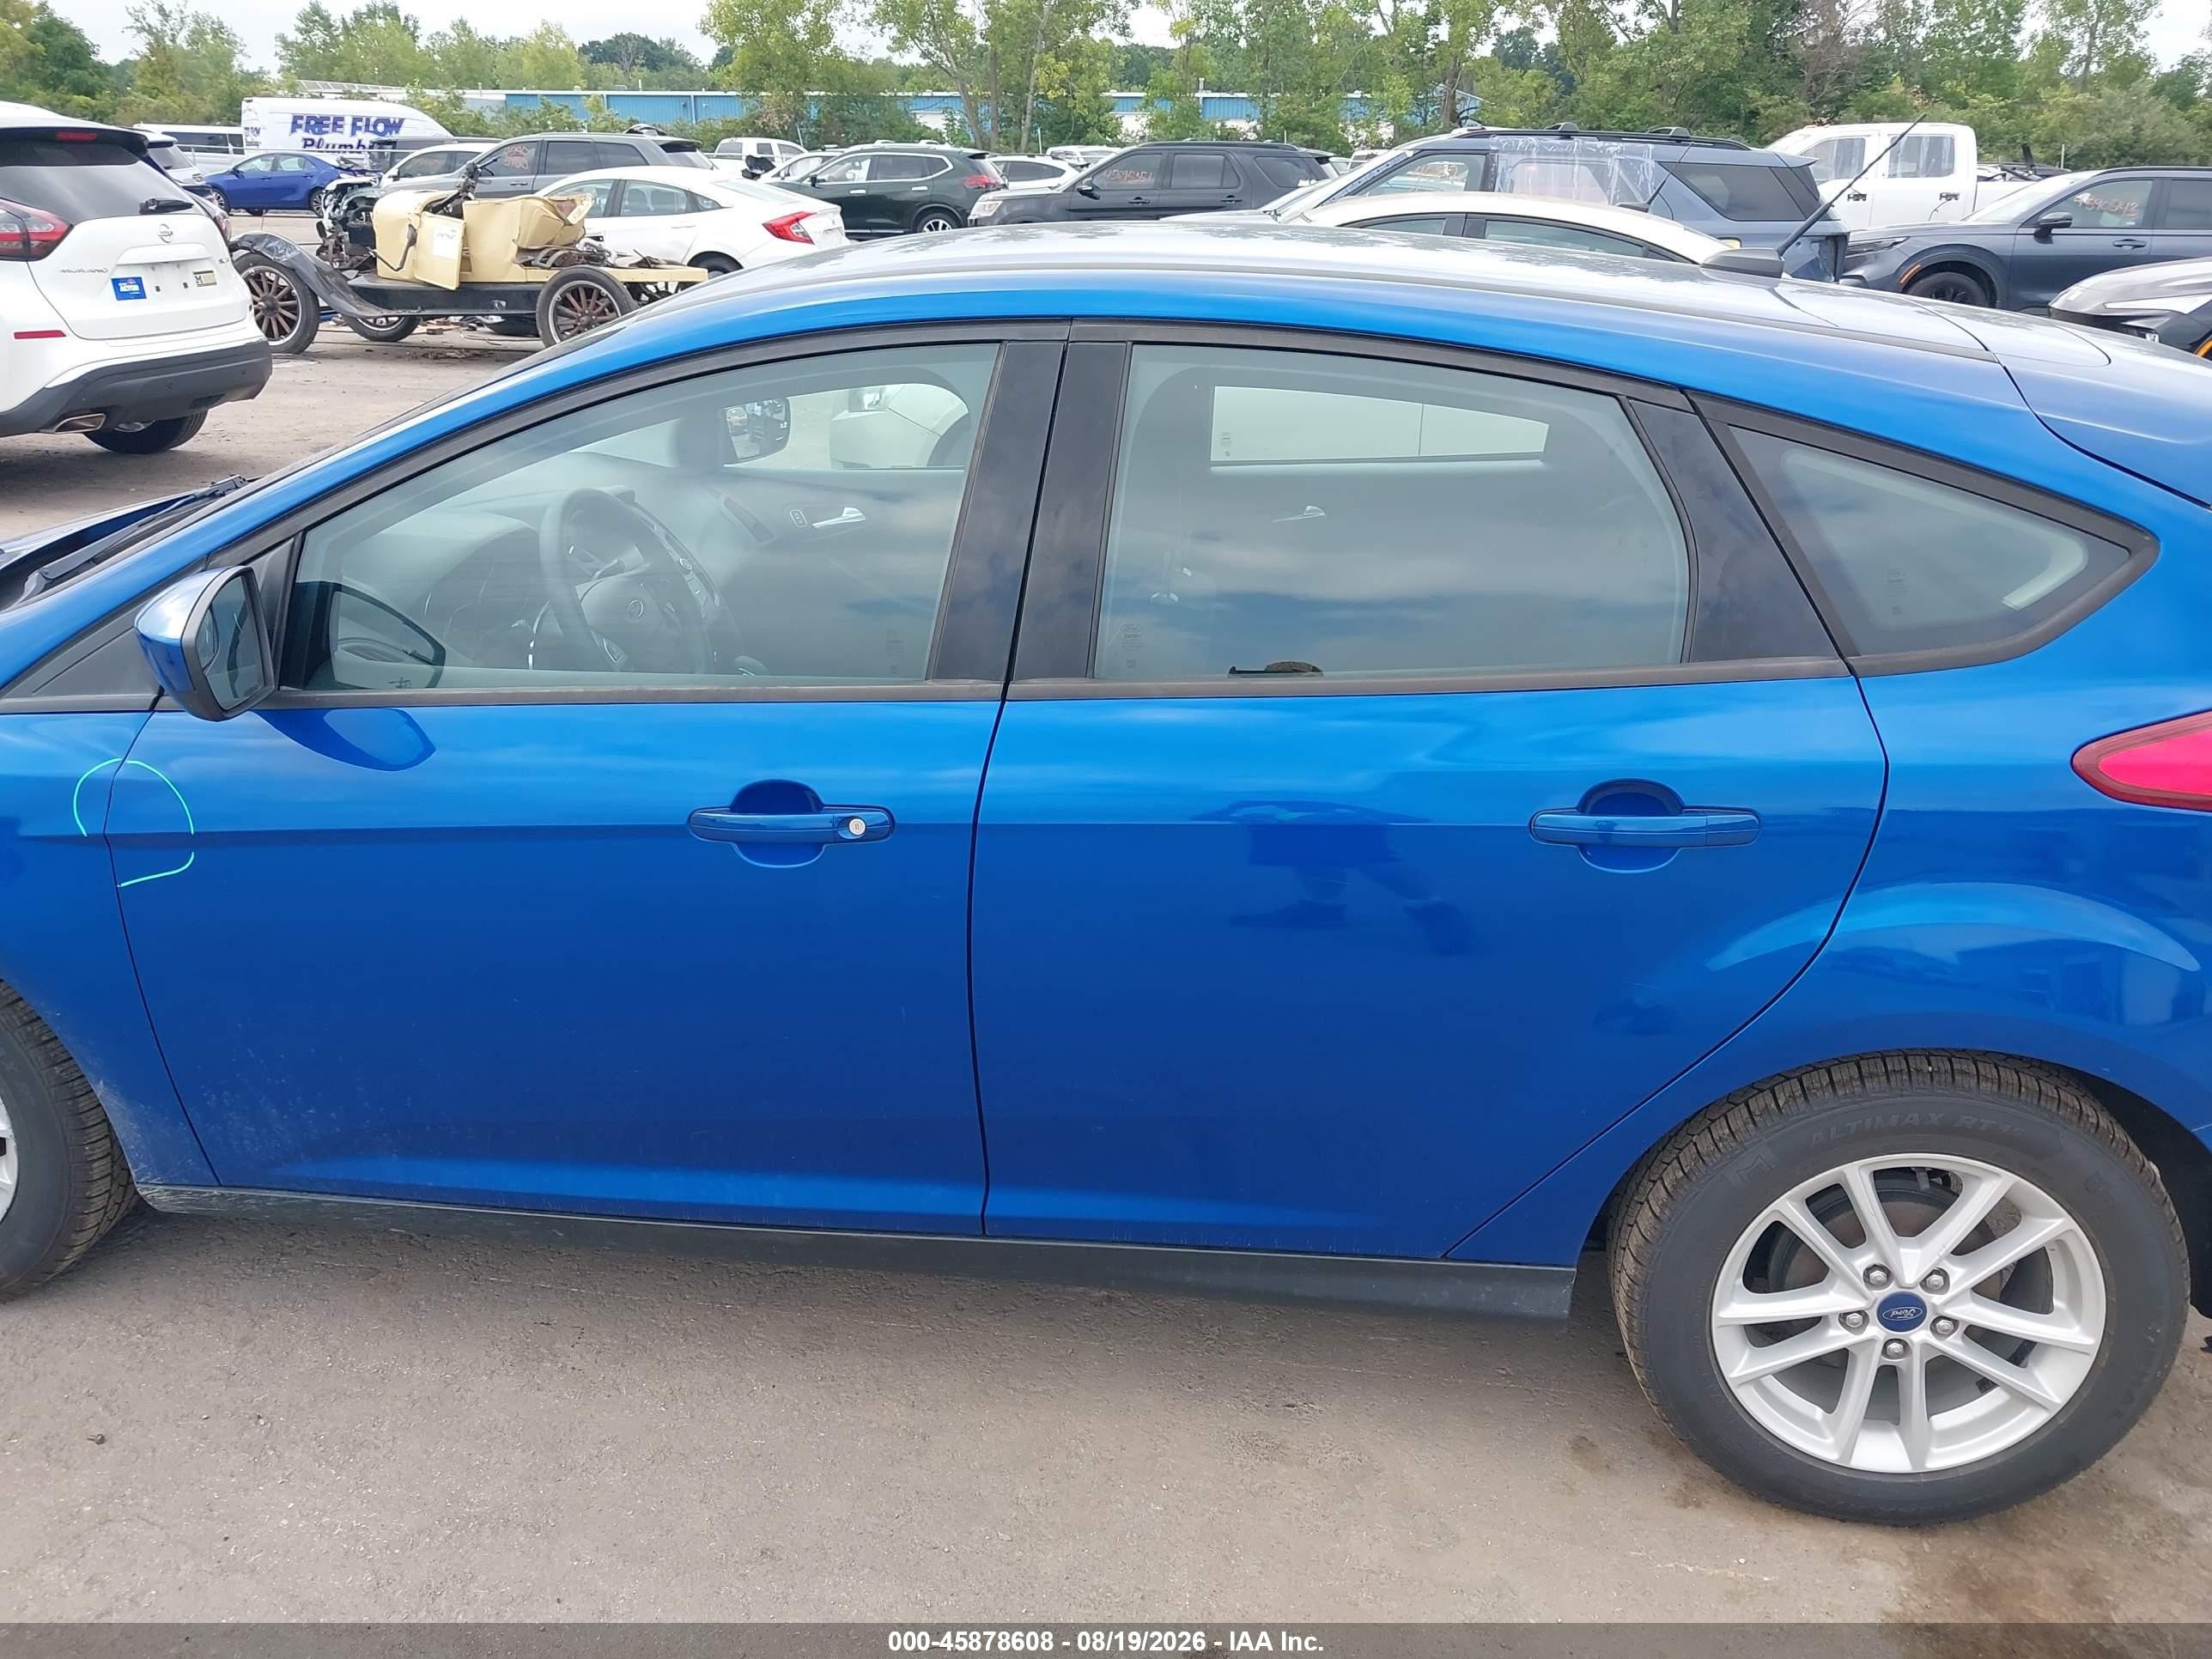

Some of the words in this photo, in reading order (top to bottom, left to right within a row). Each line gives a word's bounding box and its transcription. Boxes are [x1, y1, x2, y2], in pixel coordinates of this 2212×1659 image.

[290, 115, 344, 135] FREE
[350, 118, 404, 137] FLOW
[302, 137, 372, 154] Plumb
[1810, 1112, 1946, 1148] ALTIMAX
